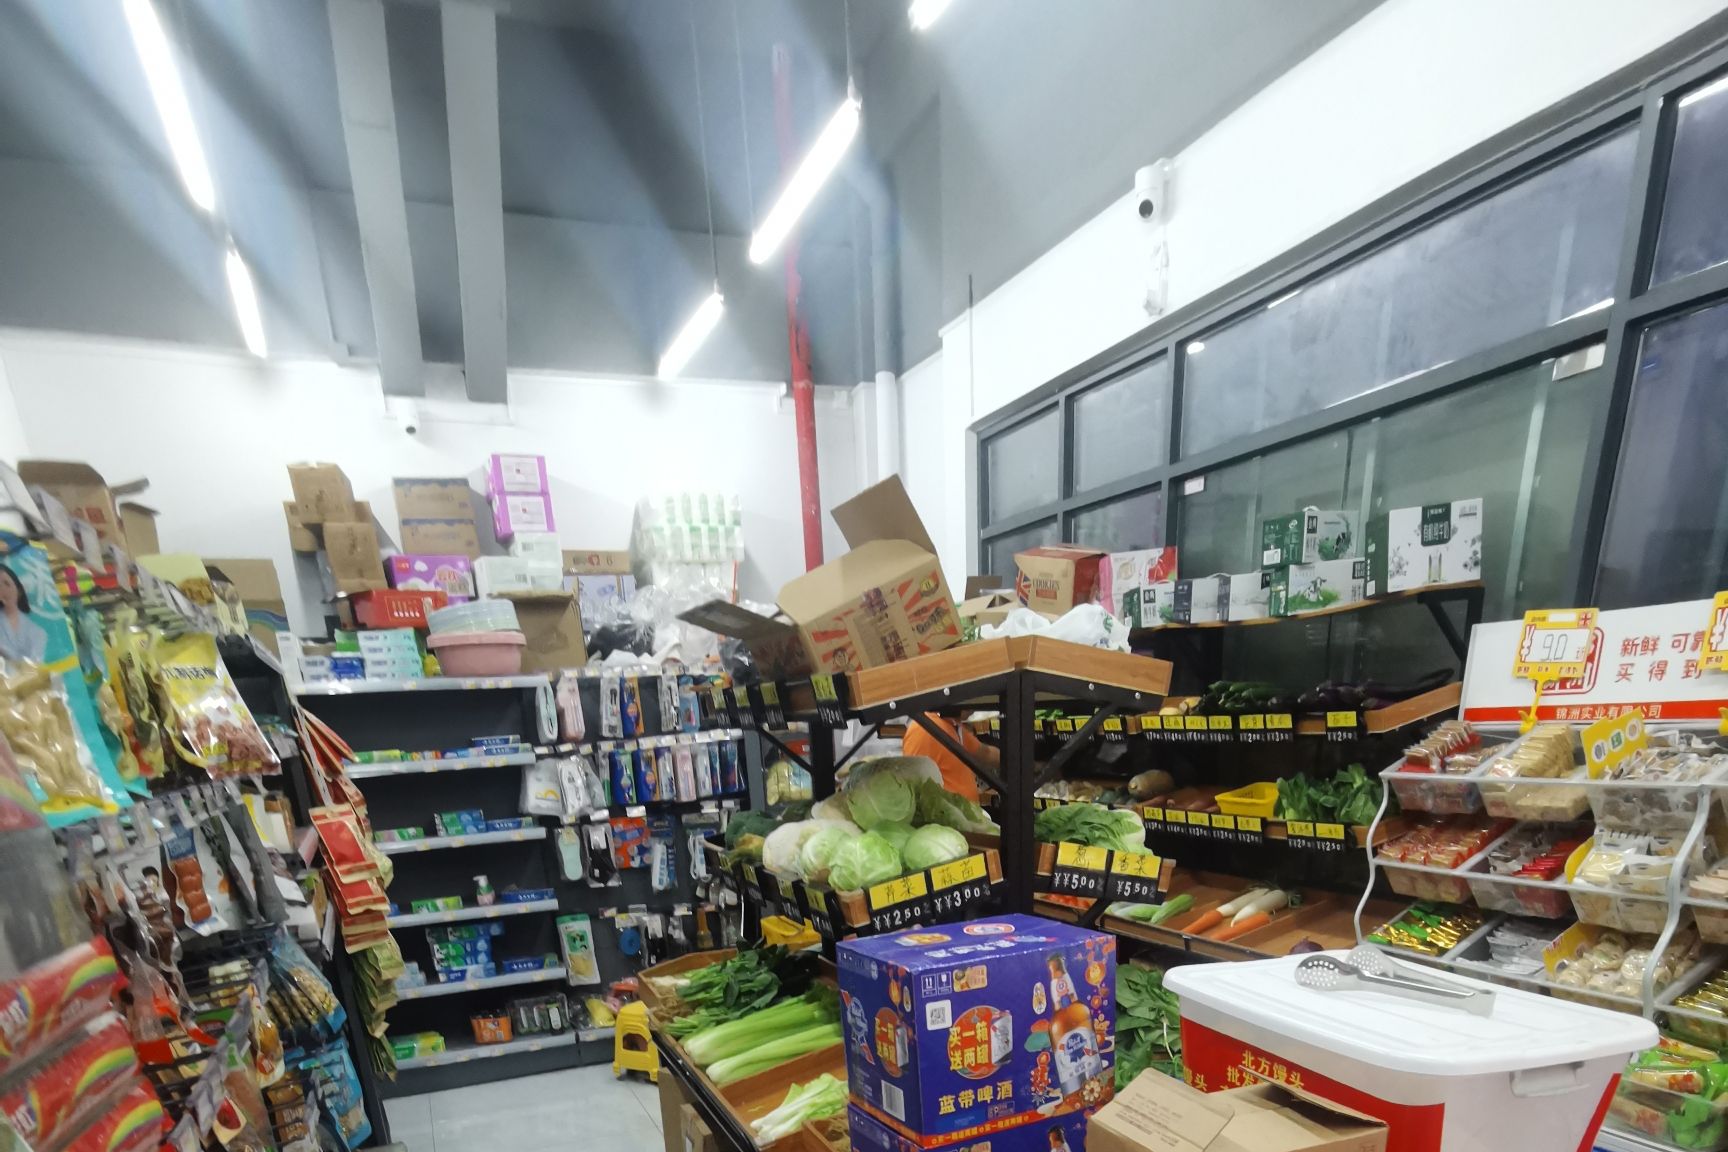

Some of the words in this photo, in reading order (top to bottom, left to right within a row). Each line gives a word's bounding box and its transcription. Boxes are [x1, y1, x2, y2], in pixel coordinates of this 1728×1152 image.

[1620, 635, 1660, 657] 新鲜
[949, 1021, 989, 1047] 买一箱
[1241, 1050, 1305, 1090] 北方馒头
[939, 1080, 1013, 1115] 蓝带啤酒
